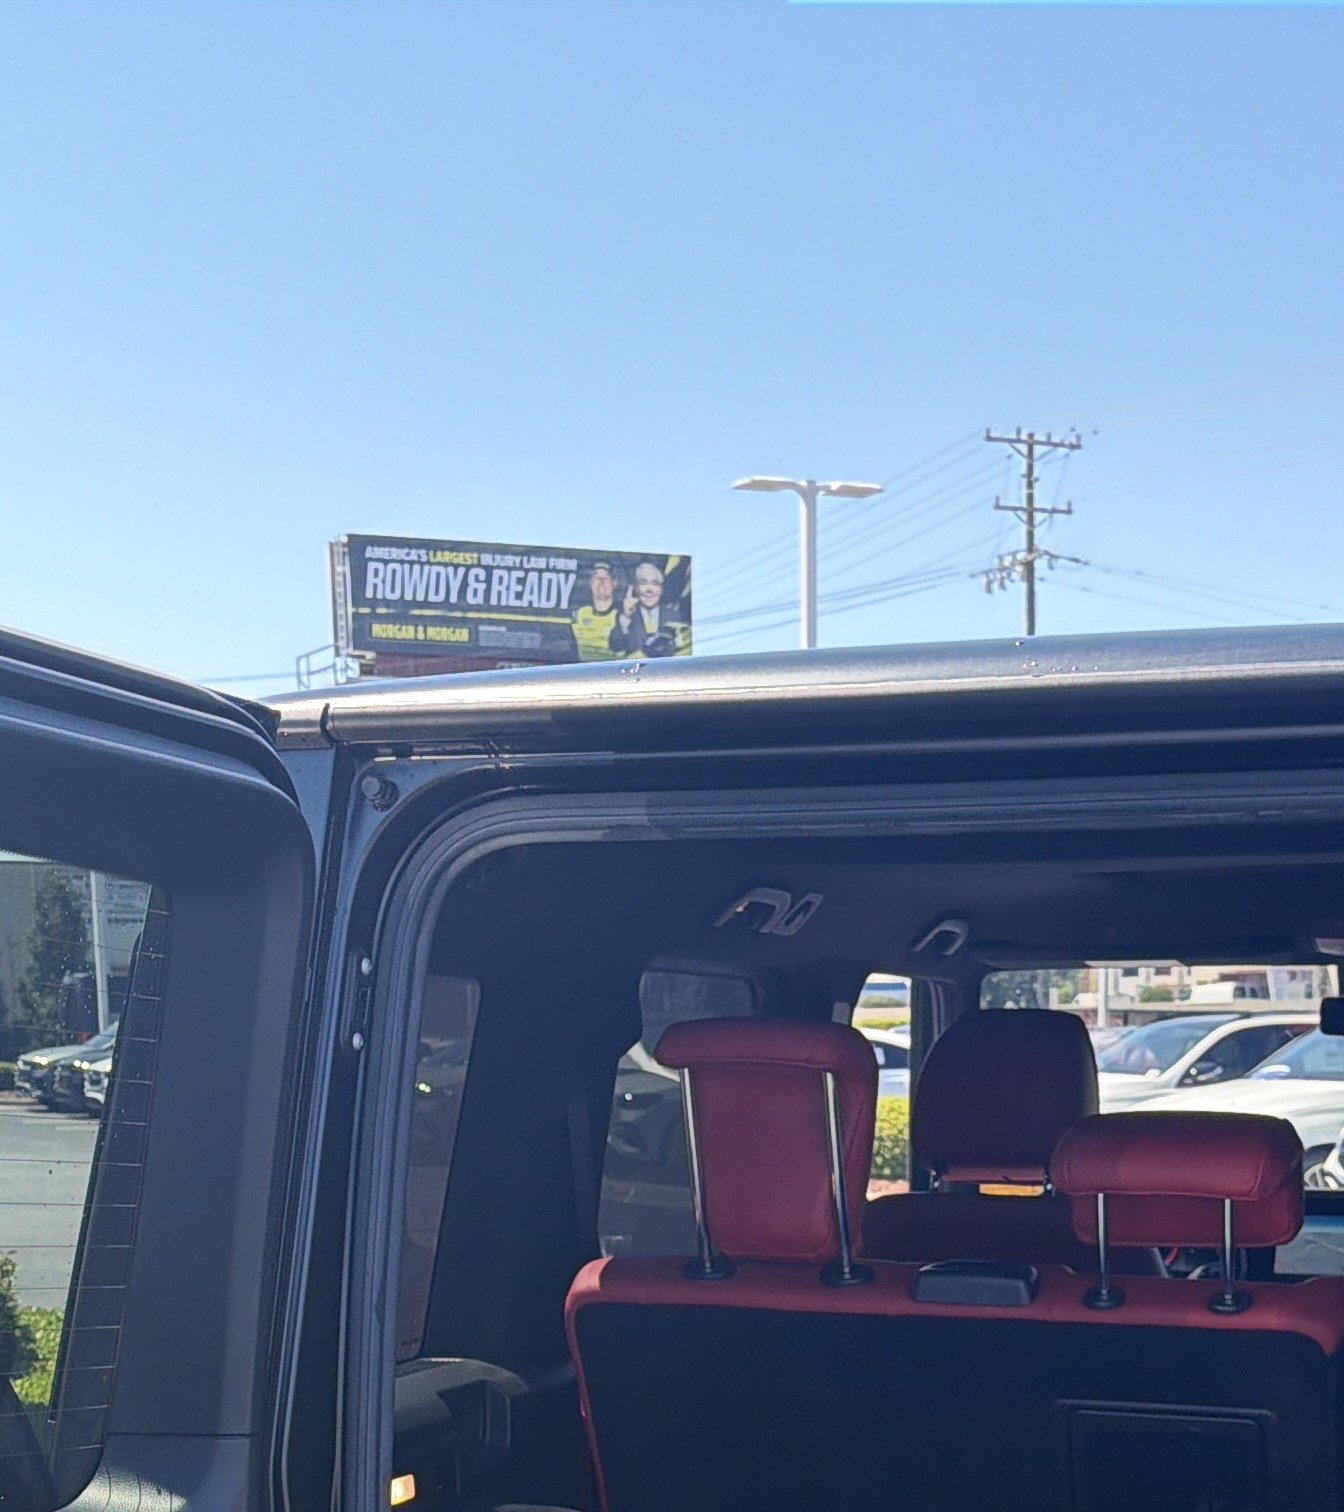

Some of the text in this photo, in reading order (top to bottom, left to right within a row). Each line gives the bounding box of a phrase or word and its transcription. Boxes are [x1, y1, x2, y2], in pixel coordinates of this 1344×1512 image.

[429, 551, 478, 565] LARGEST
[522, 555, 547, 569] LAW
[365, 561, 577, 609] ROWDY & READY
